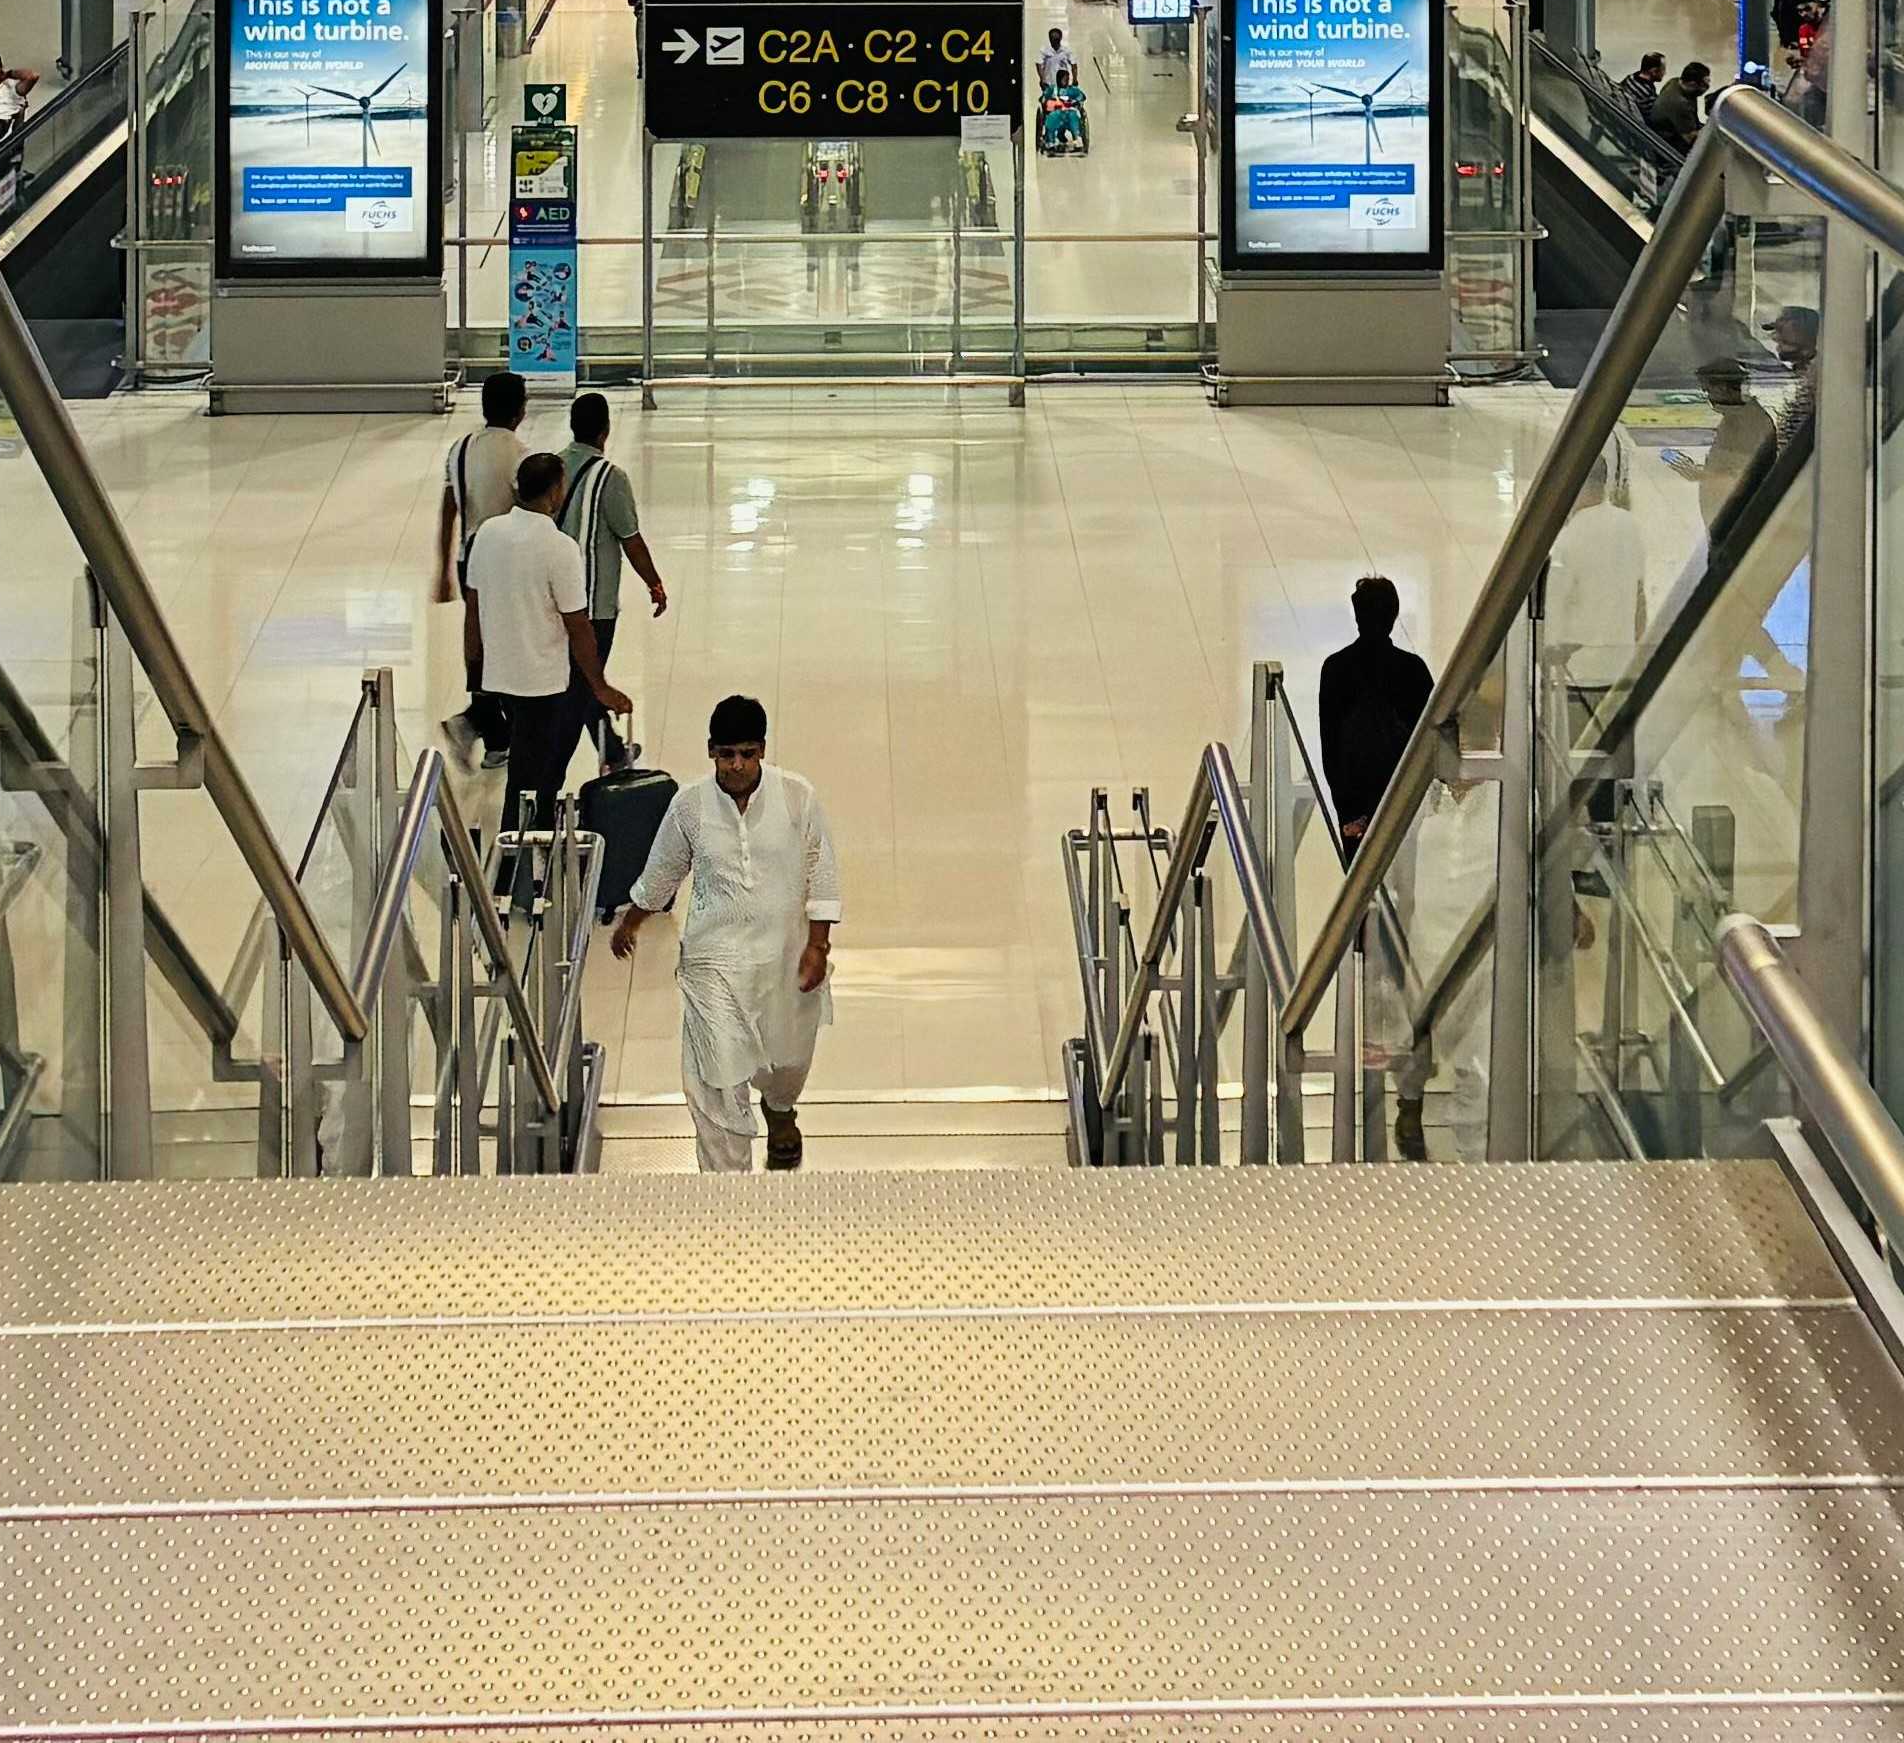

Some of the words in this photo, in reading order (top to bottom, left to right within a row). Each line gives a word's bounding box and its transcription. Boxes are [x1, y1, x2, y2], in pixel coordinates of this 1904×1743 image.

[376, 0, 391, 16] a
[244, 19, 306, 41] wind
[314, 19, 409, 41] turbine.
[1248, 18, 1308, 40] wind
[1316, 18, 1410, 40] turbine.
[758, 29, 839, 63] C2A
[864, 29, 916, 63] C2
[941, 29, 994, 63] C4
[245, 61, 289, 70] MOVING
[293, 61, 322, 70] YOUR
[325, 61, 364, 70] WORLD
[1249, 59, 1293, 68] MOVING
[1296, 59, 1324, 68] YOUR
[1327, 59, 1366, 68] WORLD
[758, 80, 811, 114] C6
[836, 80, 888, 114] C8
[913, 80, 990, 113] C10
[362, 210, 397, 219] FUCHS
[536, 207, 570, 221] AED
[1365, 207, 1400, 216] FUCHS
